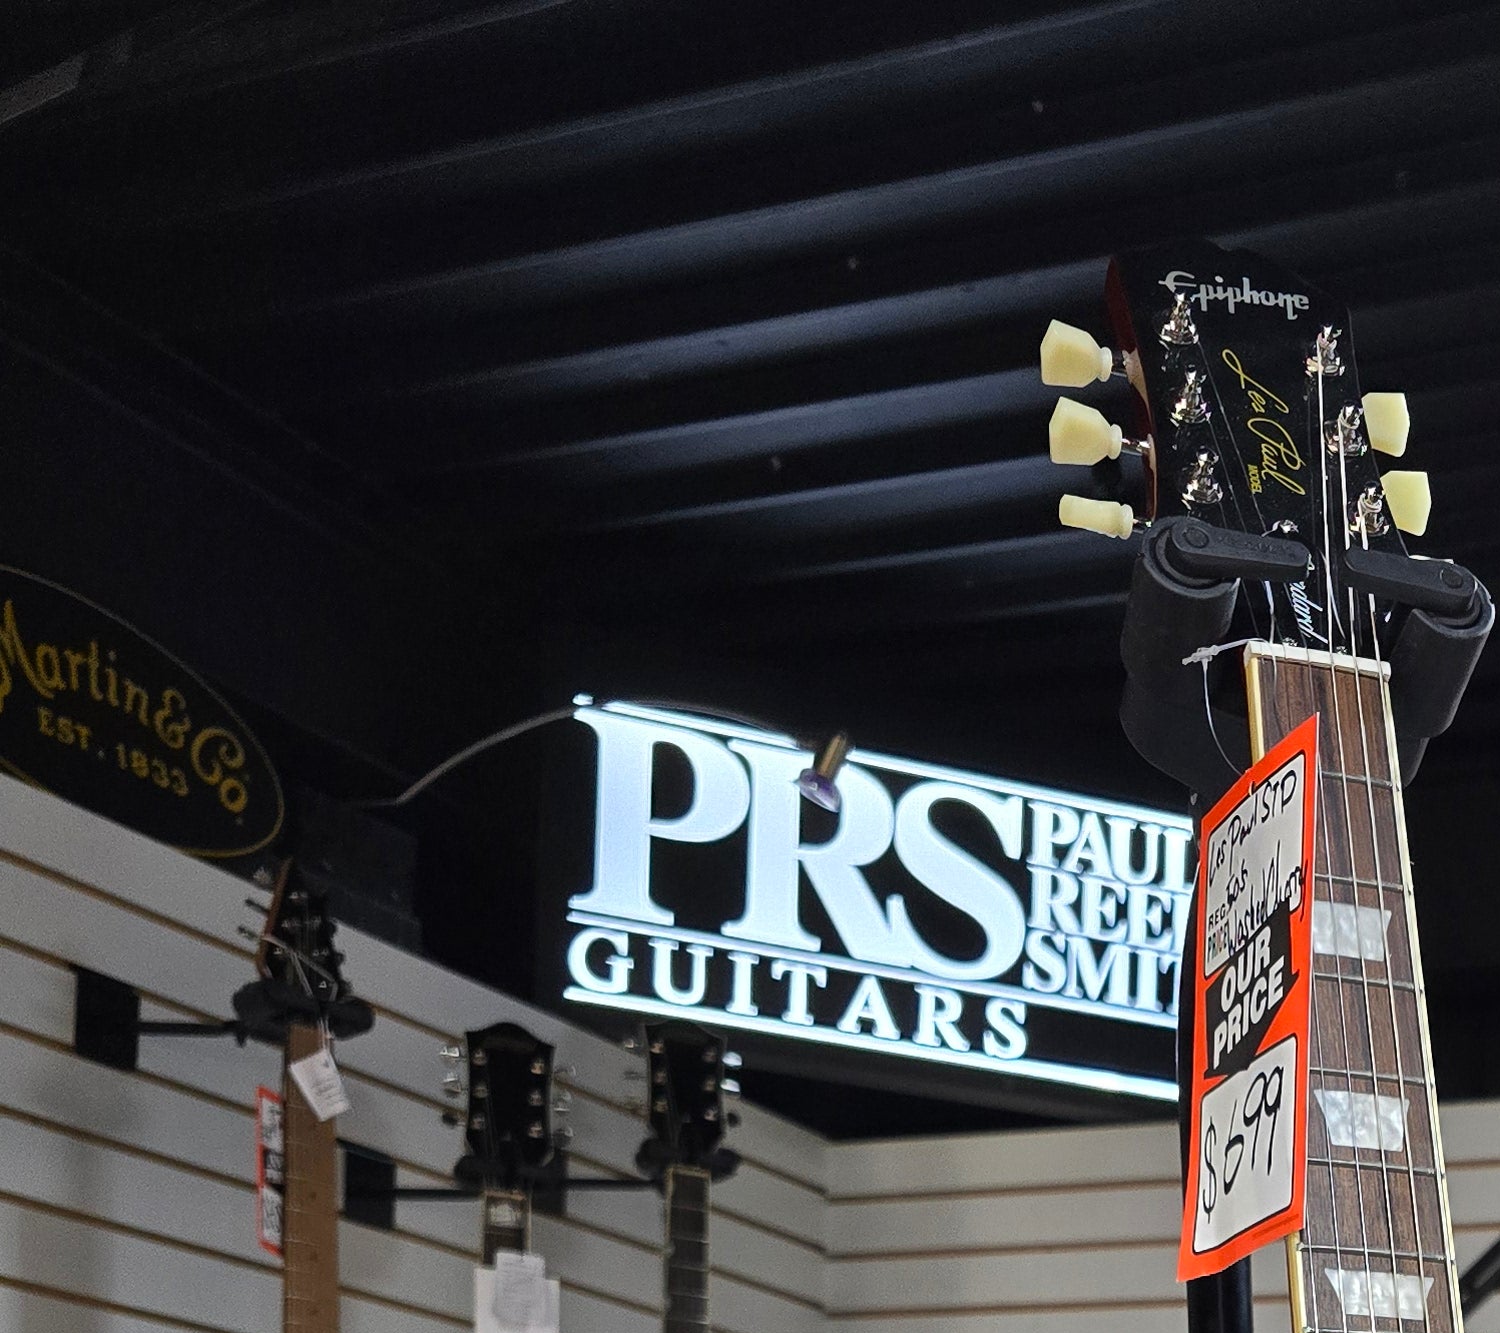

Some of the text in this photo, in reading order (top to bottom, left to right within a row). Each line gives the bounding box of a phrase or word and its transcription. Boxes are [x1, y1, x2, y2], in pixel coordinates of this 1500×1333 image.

[1158, 270, 1310, 321] Epiphone
[1221, 348, 1290, 414] Les
[1247, 417, 1308, 496] Paul
[1260, 769, 1298, 824] STD
[567, 705, 1028, 982] PRS
[566, 927, 1030, 1060] GUITARS
[1212, 954, 1285, 1071] PRICE
[1220, 923, 1272, 1013] OUR
[1202, 1065, 1284, 1225] $699
